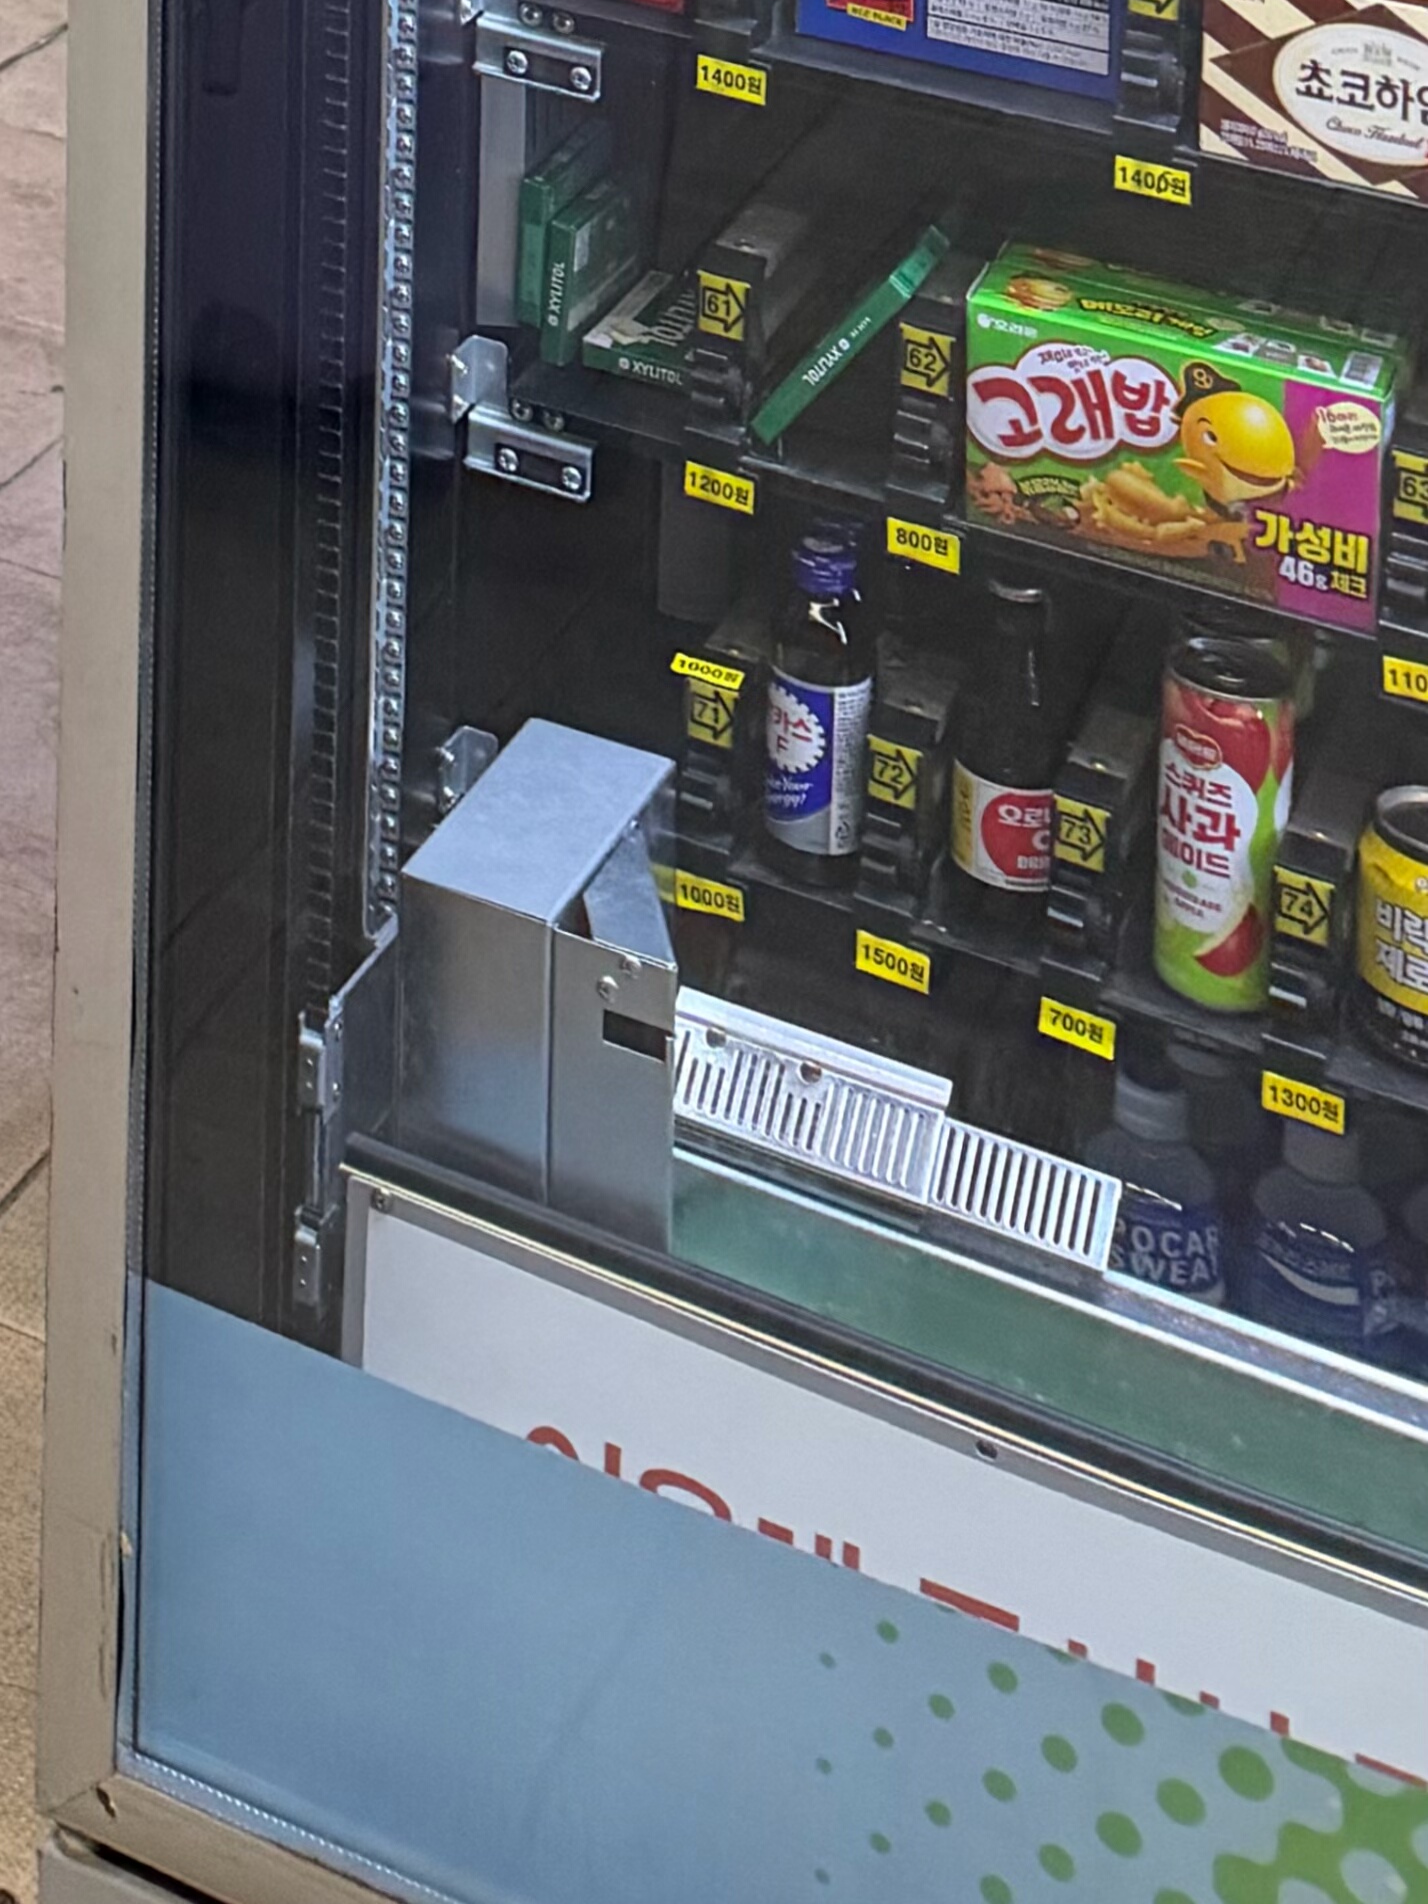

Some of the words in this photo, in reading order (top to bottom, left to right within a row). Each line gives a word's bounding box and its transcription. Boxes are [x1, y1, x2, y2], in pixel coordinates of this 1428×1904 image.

[700, 64, 762, 97] 1400원
[1118, 165, 1187, 198] 1400원
[707, 295, 733, 317] 61
[632, 359, 683, 386] XYLITOL
[802, 345, 842, 387] XYLITOL
[908, 347, 937, 372] 62
[972, 368, 1171, 448] 고래밥
[689, 470, 749, 505] 1200원
[895, 527, 949, 558] 800원
[1254, 508, 1370, 574] 가성비
[678, 657, 739, 686] 1000원
[694, 702, 720, 723] 71
[876, 758, 903, 778] 72
[1164, 761, 1233, 809] 스퀴즈
[1060, 821, 1091, 846] 73
[1161, 786, 1241, 852] 사과
[679, 882, 741, 915] 1000원
[1284, 893, 1316, 918] 74
[861, 942, 925, 983] 1500원
[1048, 1009, 1104, 1045] 700원
[1268, 1083, 1340, 1122] 1300원
